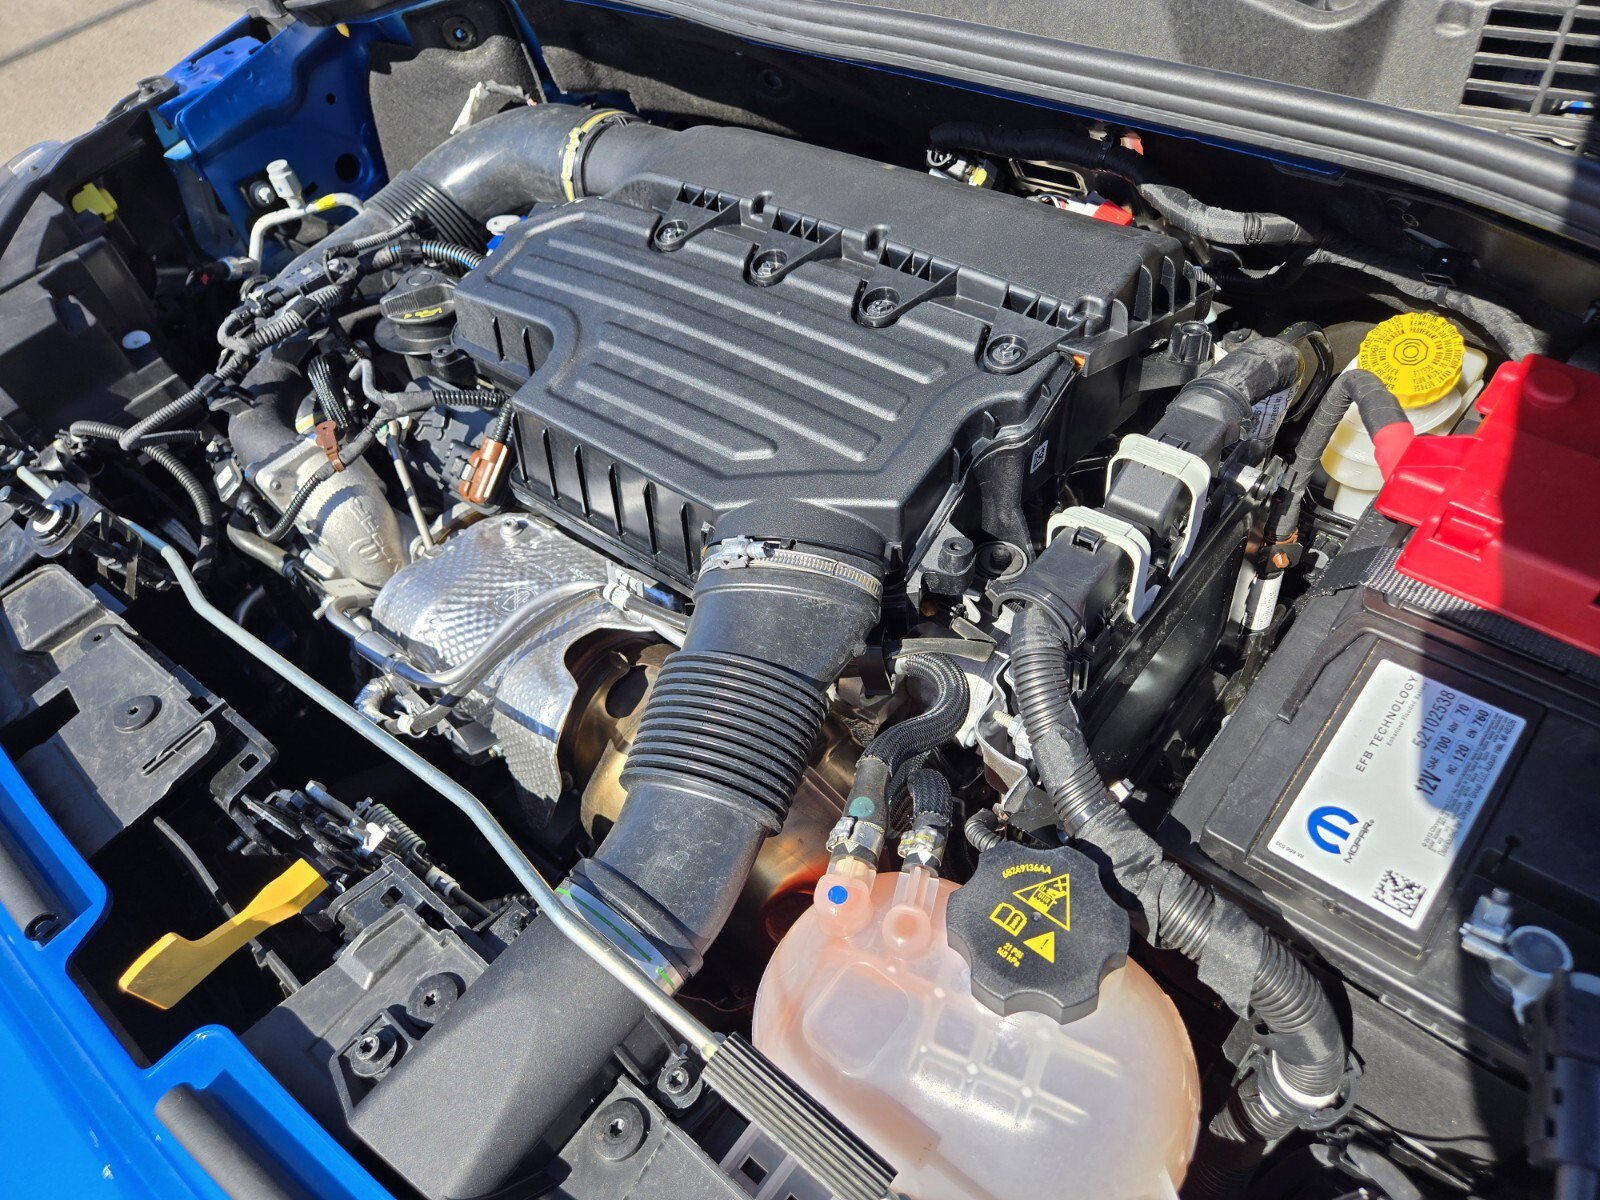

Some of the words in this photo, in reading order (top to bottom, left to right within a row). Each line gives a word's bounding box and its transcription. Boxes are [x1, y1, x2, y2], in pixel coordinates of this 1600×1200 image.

[1354, 749, 1373, 772] EFB
[1370, 675, 1418, 747] TECHNOLOGY
[1410, 688, 1456, 749] 52102538
[1454, 702, 1470, 717] 70
[1432, 734, 1452, 754] 700
[1451, 743, 1470, 763] 120
[1465, 727, 1477, 739] EN
[1471, 708, 1489, 727] 760
[1425, 755, 1440, 770] SAE
[1412, 768, 1443, 797] 12V
